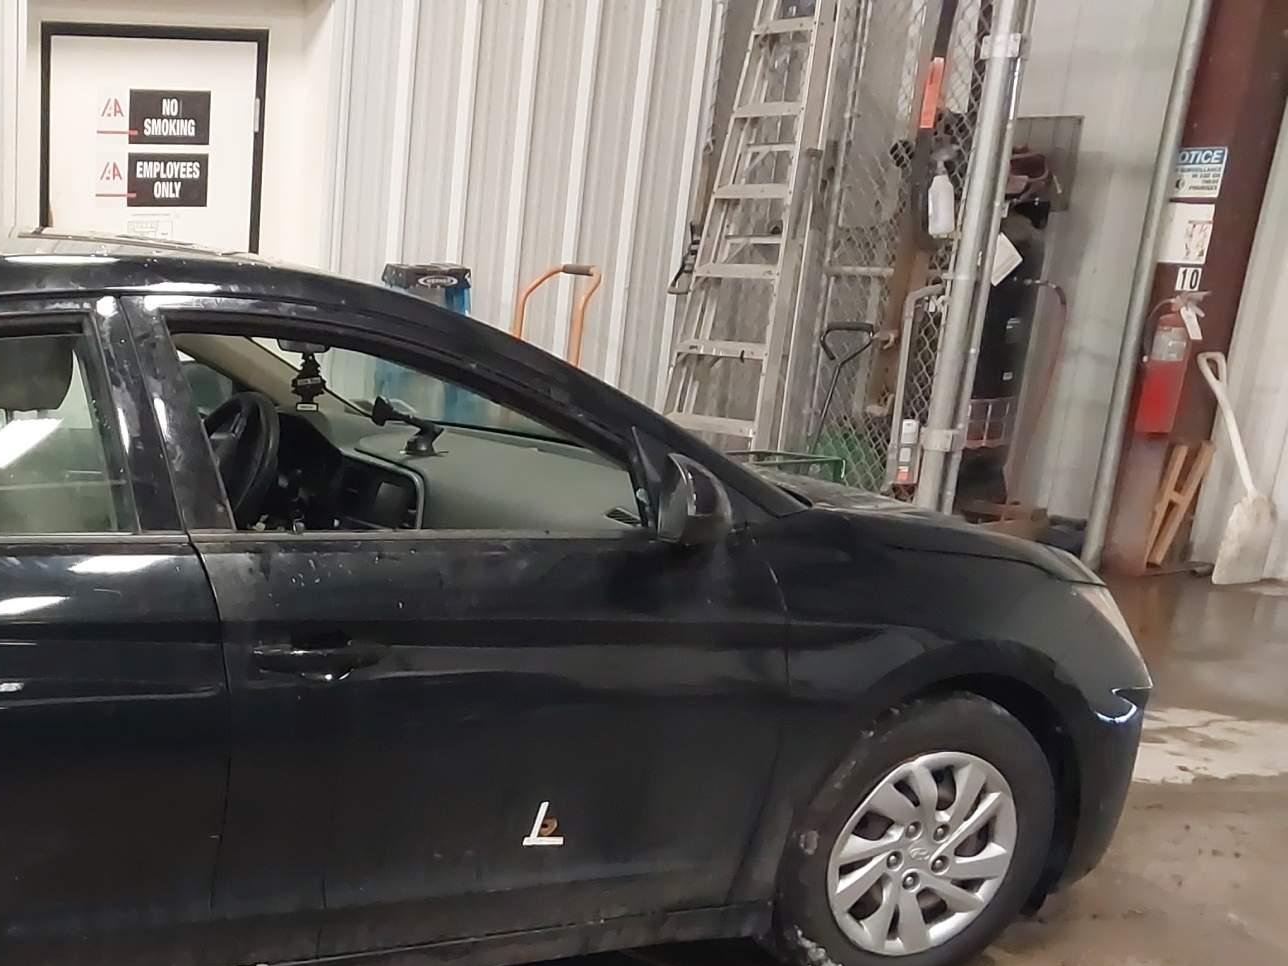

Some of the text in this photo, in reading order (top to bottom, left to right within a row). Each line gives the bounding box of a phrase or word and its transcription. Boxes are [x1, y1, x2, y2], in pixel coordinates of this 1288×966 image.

[162, 98, 179, 116] NO
[143, 118, 196, 136] SMOKING
[1177, 150, 1224, 164] OTICE
[136, 161, 200, 178] EMPLOYEES
[153, 181, 182, 198] ONLY
[1181, 268, 1200, 290] 10
